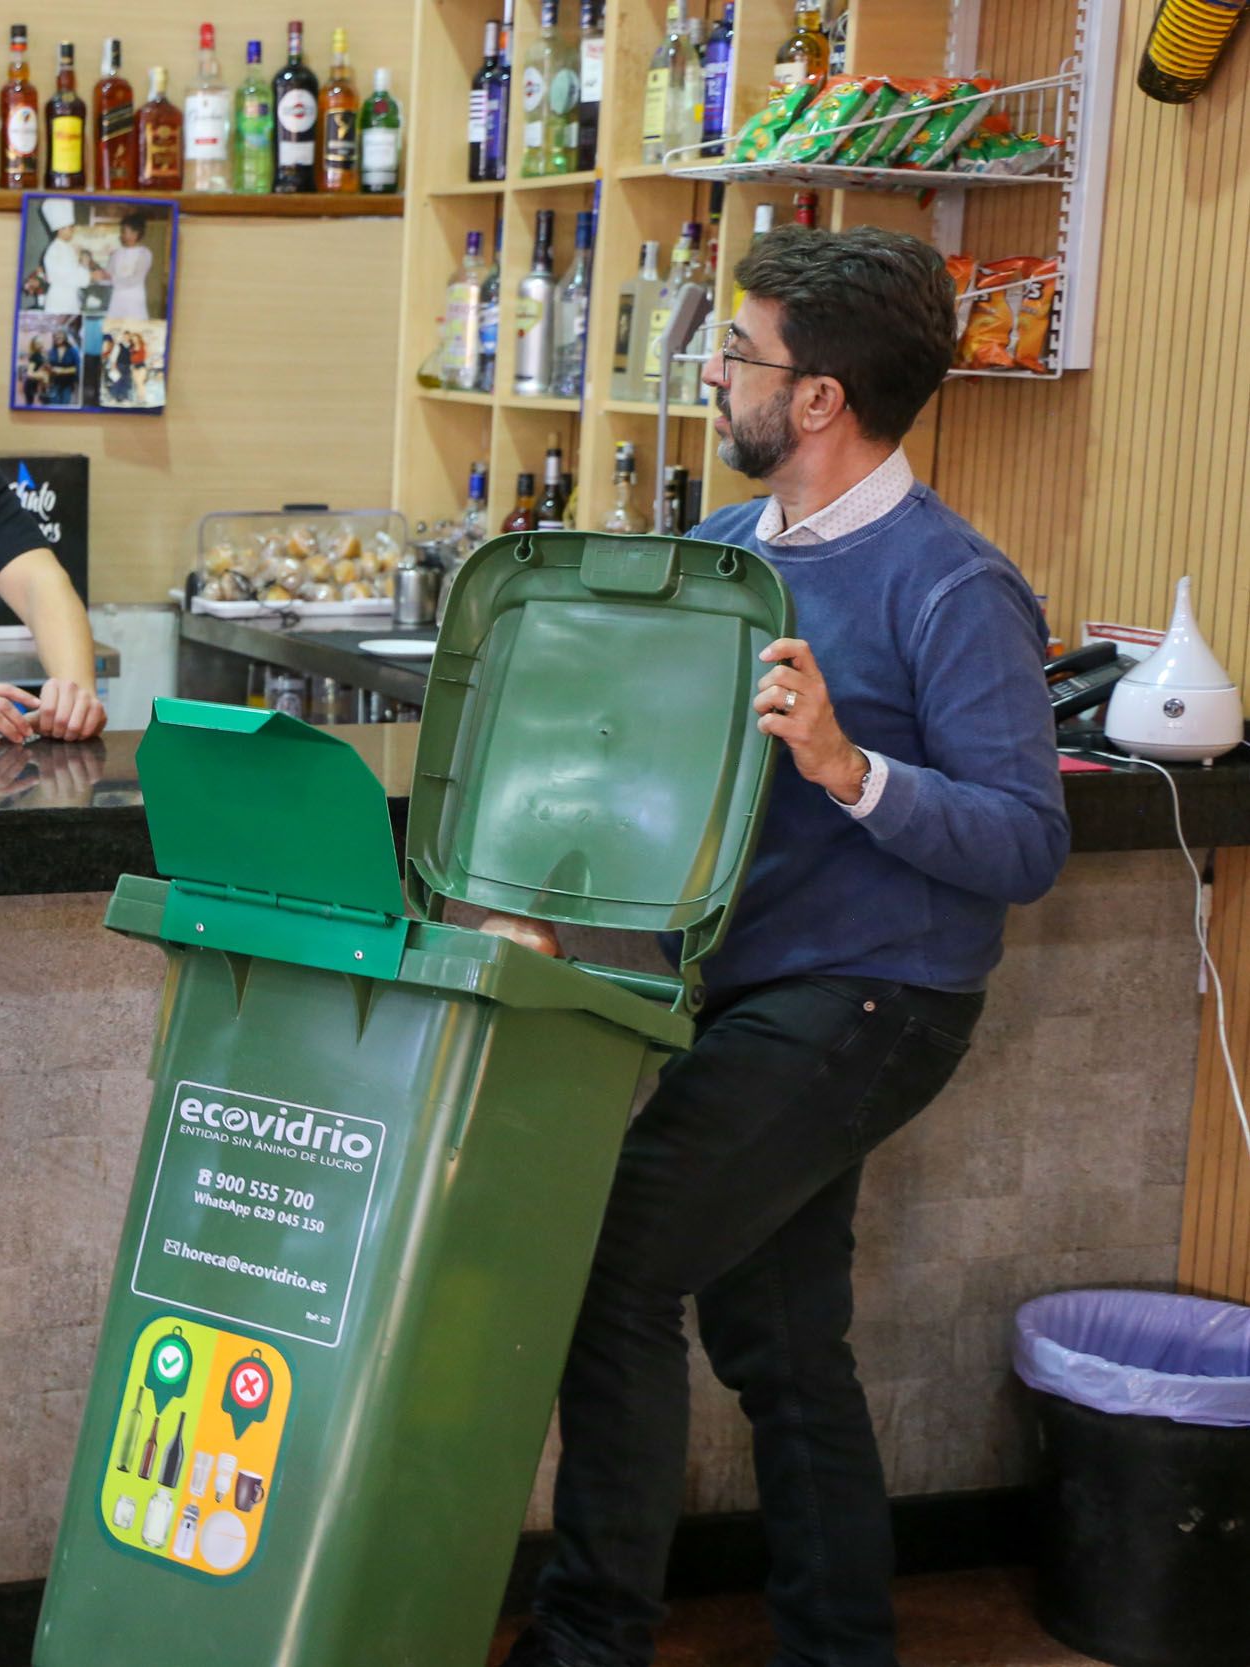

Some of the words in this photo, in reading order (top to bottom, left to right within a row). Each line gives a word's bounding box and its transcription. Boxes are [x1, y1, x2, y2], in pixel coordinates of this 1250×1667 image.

[179, 1124, 230, 1143] ENTIDAD
[232, 1135, 252, 1149] SIN
[254, 1139, 298, 1159] ÁNIMO
[300, 1151, 317, 1164] DE
[320, 1155, 364, 1173] LUCRO
[180, 1097, 373, 1159] ecovidrio
[194, 1190, 251, 1218] WhatsApp
[253, 1205, 276, 1222] 629
[277, 1211, 301, 1227] 045
[301, 1217, 325, 1233] 150
[215, 1172, 246, 1194] 900
[248, 1180, 280, 1202] 555
[283, 1188, 315, 1210] 700
[181, 1242, 328, 1294] horeca@ecovidrio.es
